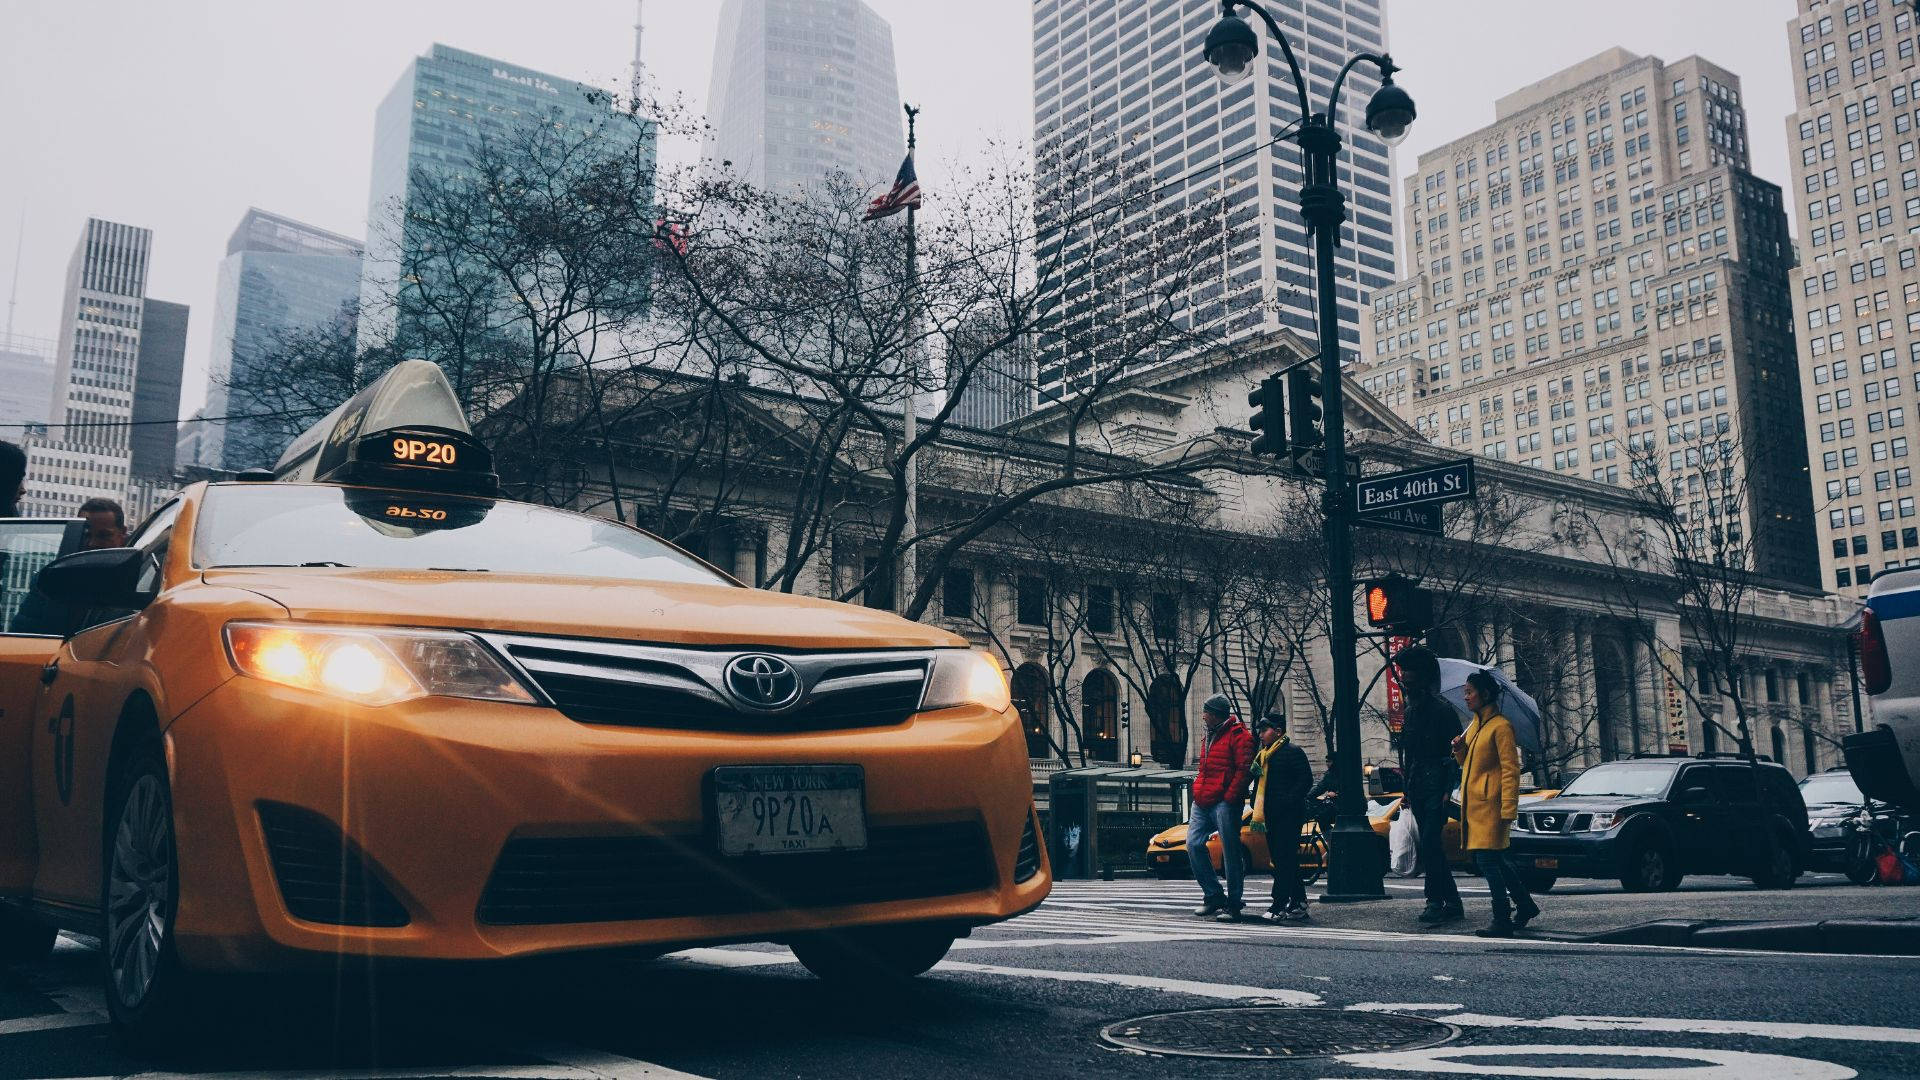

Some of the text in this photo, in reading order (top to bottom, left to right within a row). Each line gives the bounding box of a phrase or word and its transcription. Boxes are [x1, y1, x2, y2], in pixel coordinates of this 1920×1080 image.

[393, 438, 456, 465] 9P20
[1364, 473, 1461, 505] East 40th St
[1404, 508, 1427, 524] Ave
[753, 775, 828, 791] NEW YORK
[782, 839, 807, 849] TAXI
